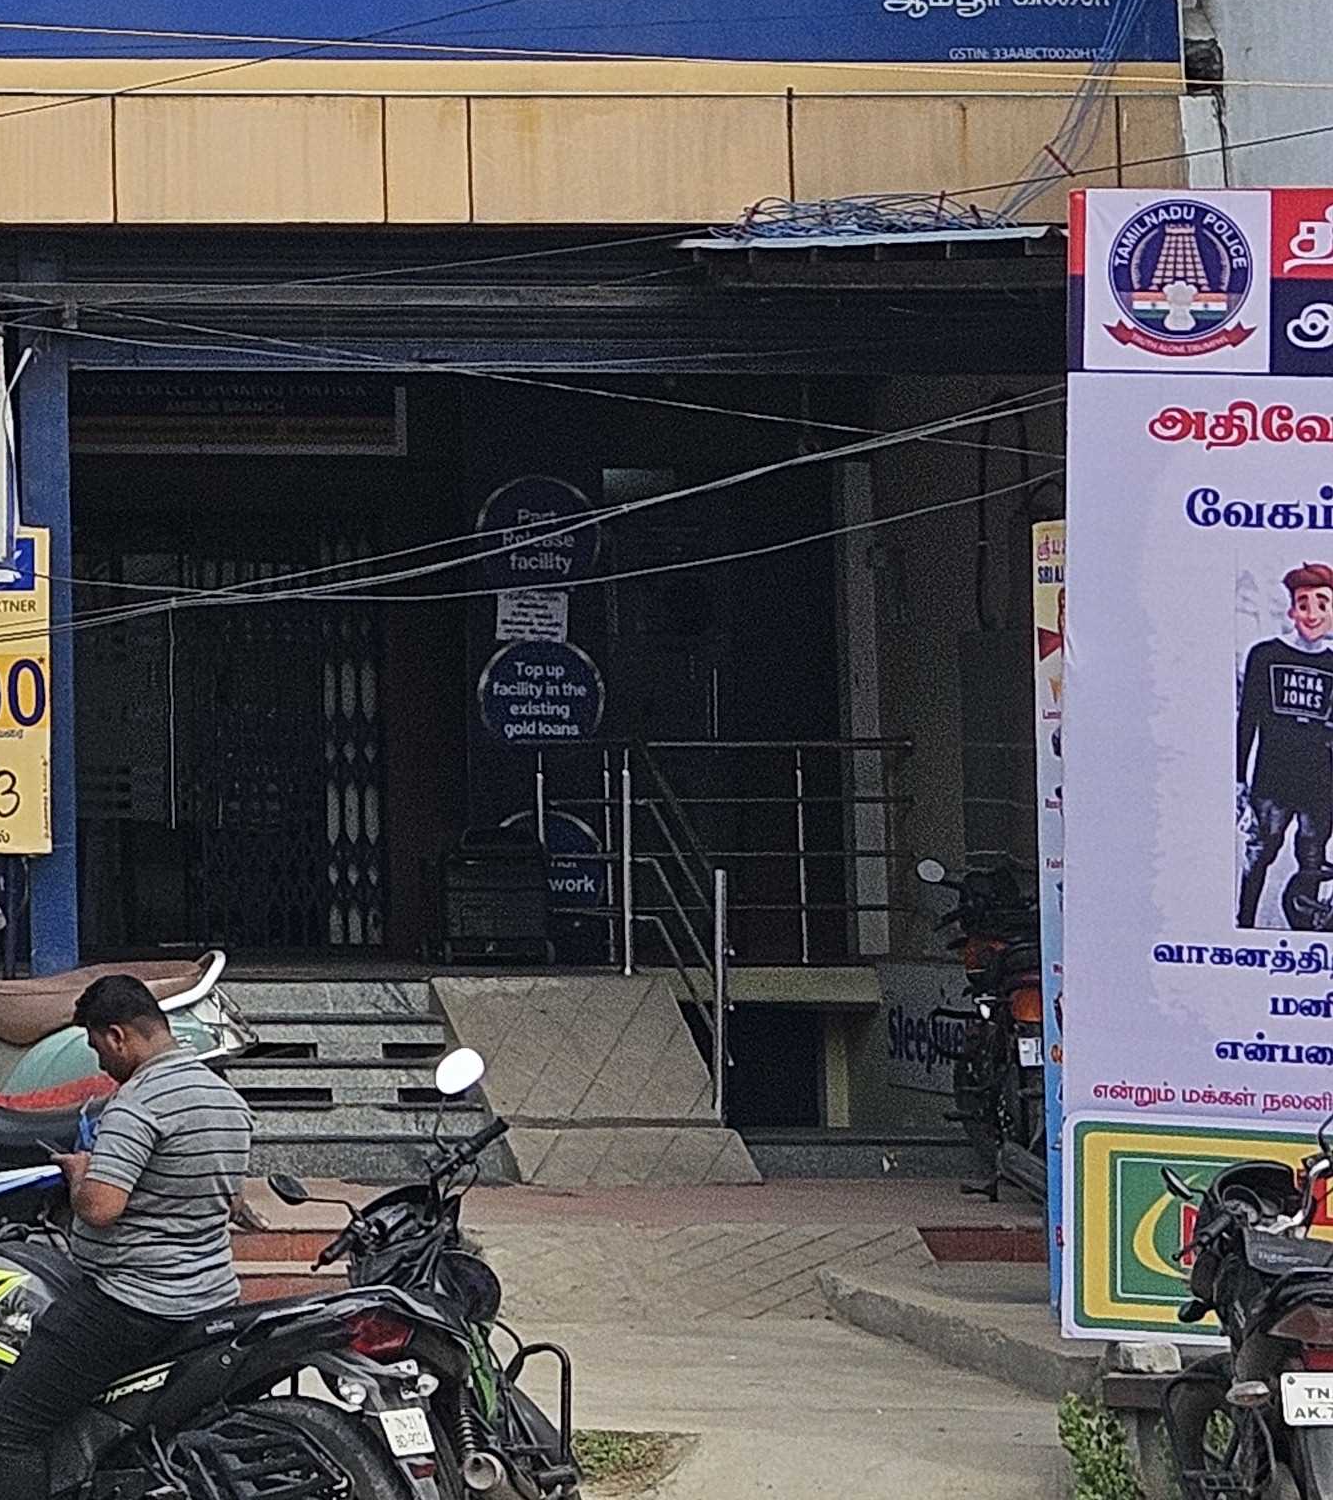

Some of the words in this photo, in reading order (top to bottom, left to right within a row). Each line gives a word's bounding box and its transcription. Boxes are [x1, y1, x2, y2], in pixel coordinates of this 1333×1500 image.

[1114, 206, 1195, 267] TAMILNADU
[1204, 212, 1248, 269] POLICE
[510, 552, 572, 574] facility
[515, 661, 543, 677] Top
[546, 665, 564, 678] up
[493, 681, 542, 698] facility
[546, 683, 559, 695] in
[562, 683, 587, 697] the
[1282, 692, 1322, 708] JONES
[510, 702, 570, 719] existing
[504, 722, 536, 739] gold
[539, 721, 579, 736] loans
[548, 875, 596, 892] work
[1094, 1082, 1175, 1106] என்றும்
[1182, 1084, 1257, 1107] மக்கள்
